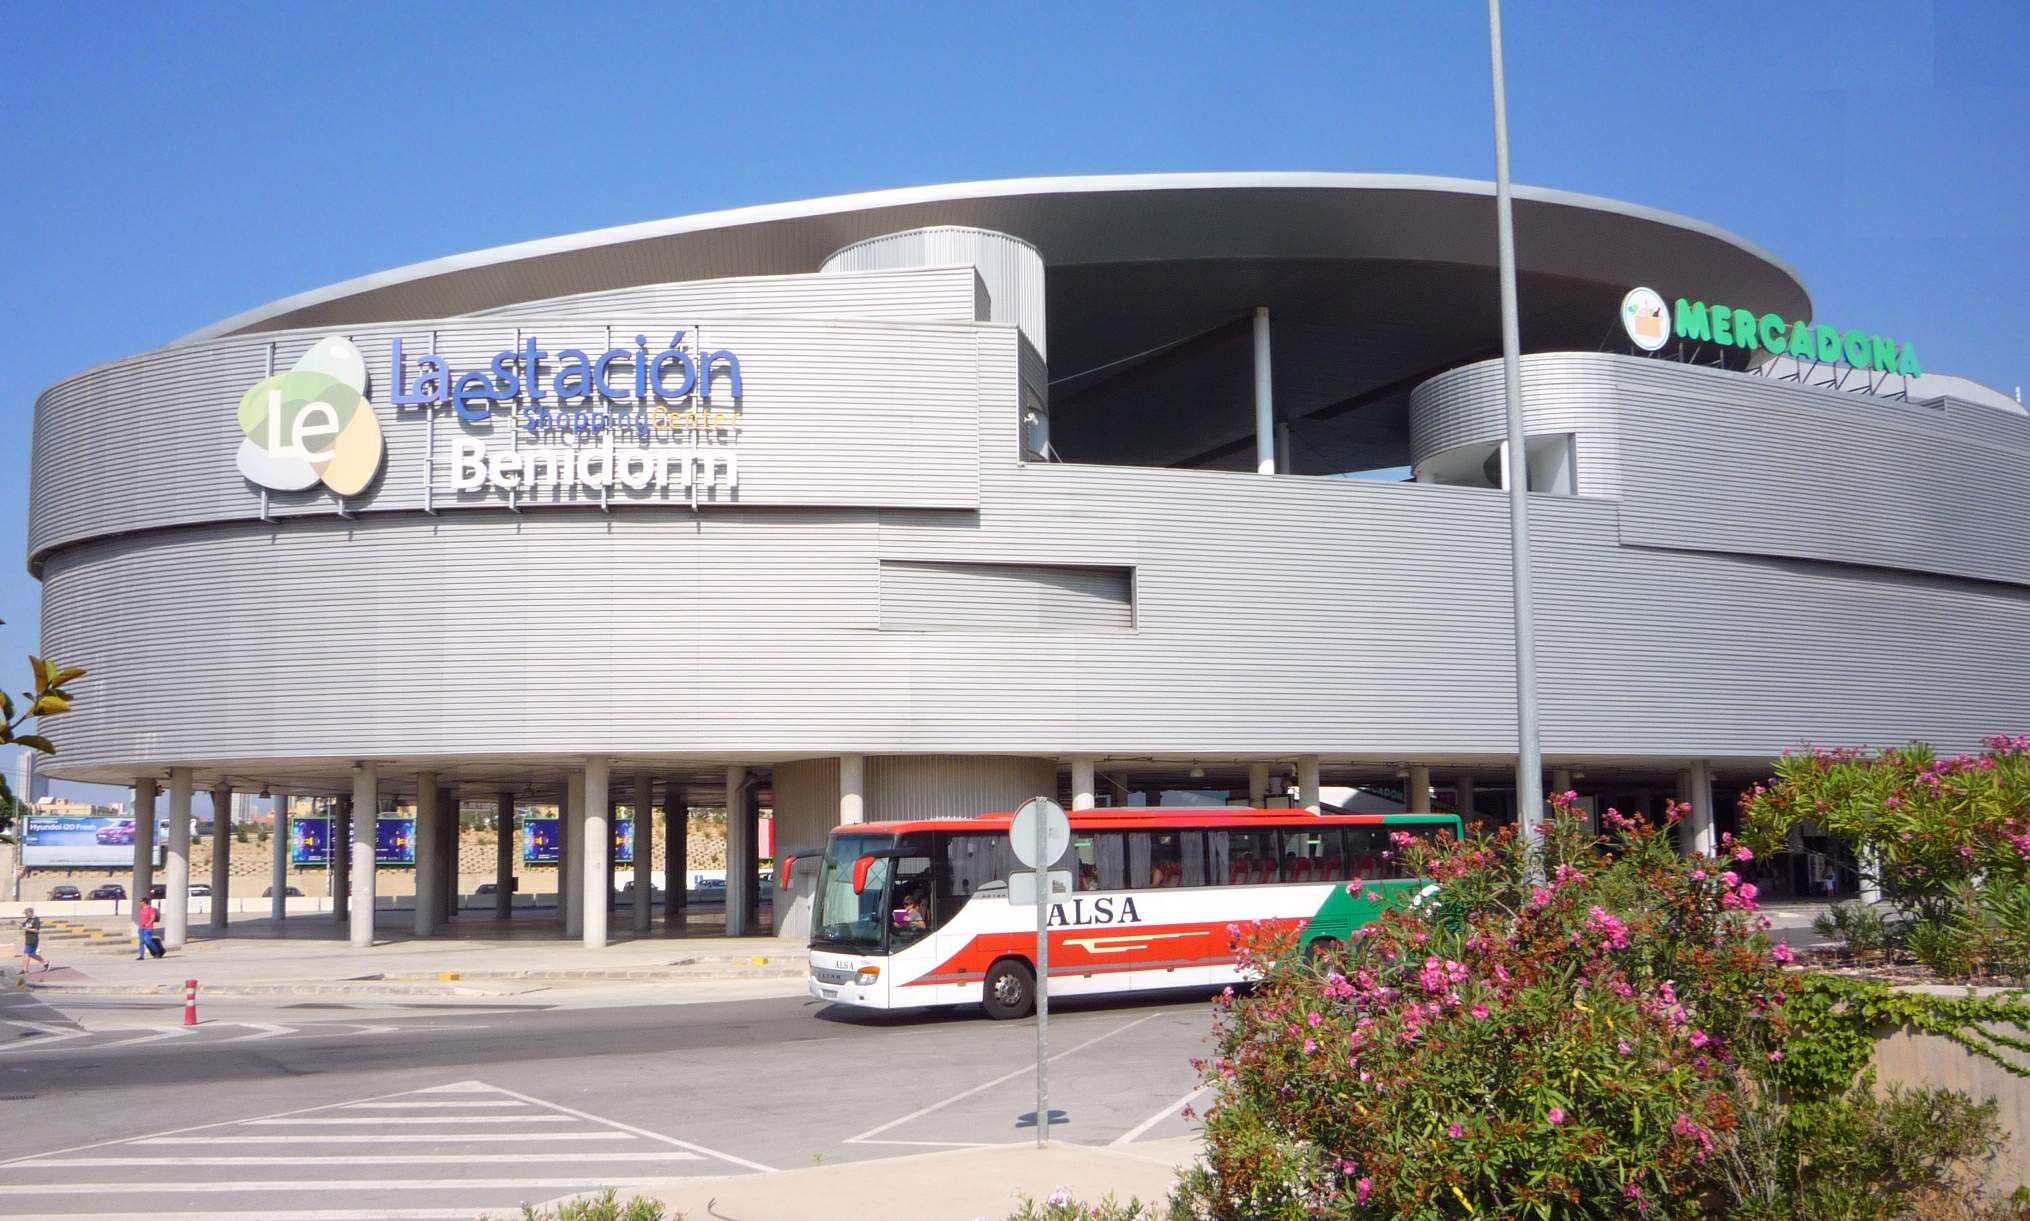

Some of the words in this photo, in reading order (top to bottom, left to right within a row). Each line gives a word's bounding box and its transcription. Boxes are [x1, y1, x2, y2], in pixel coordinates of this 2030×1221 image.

[1674, 297, 1921, 378] MERCADONA
[451, 433, 738, 490] Benidorm
[1047, 896, 1142, 927] ALSA
[834, 960, 854, 970] ALSA
